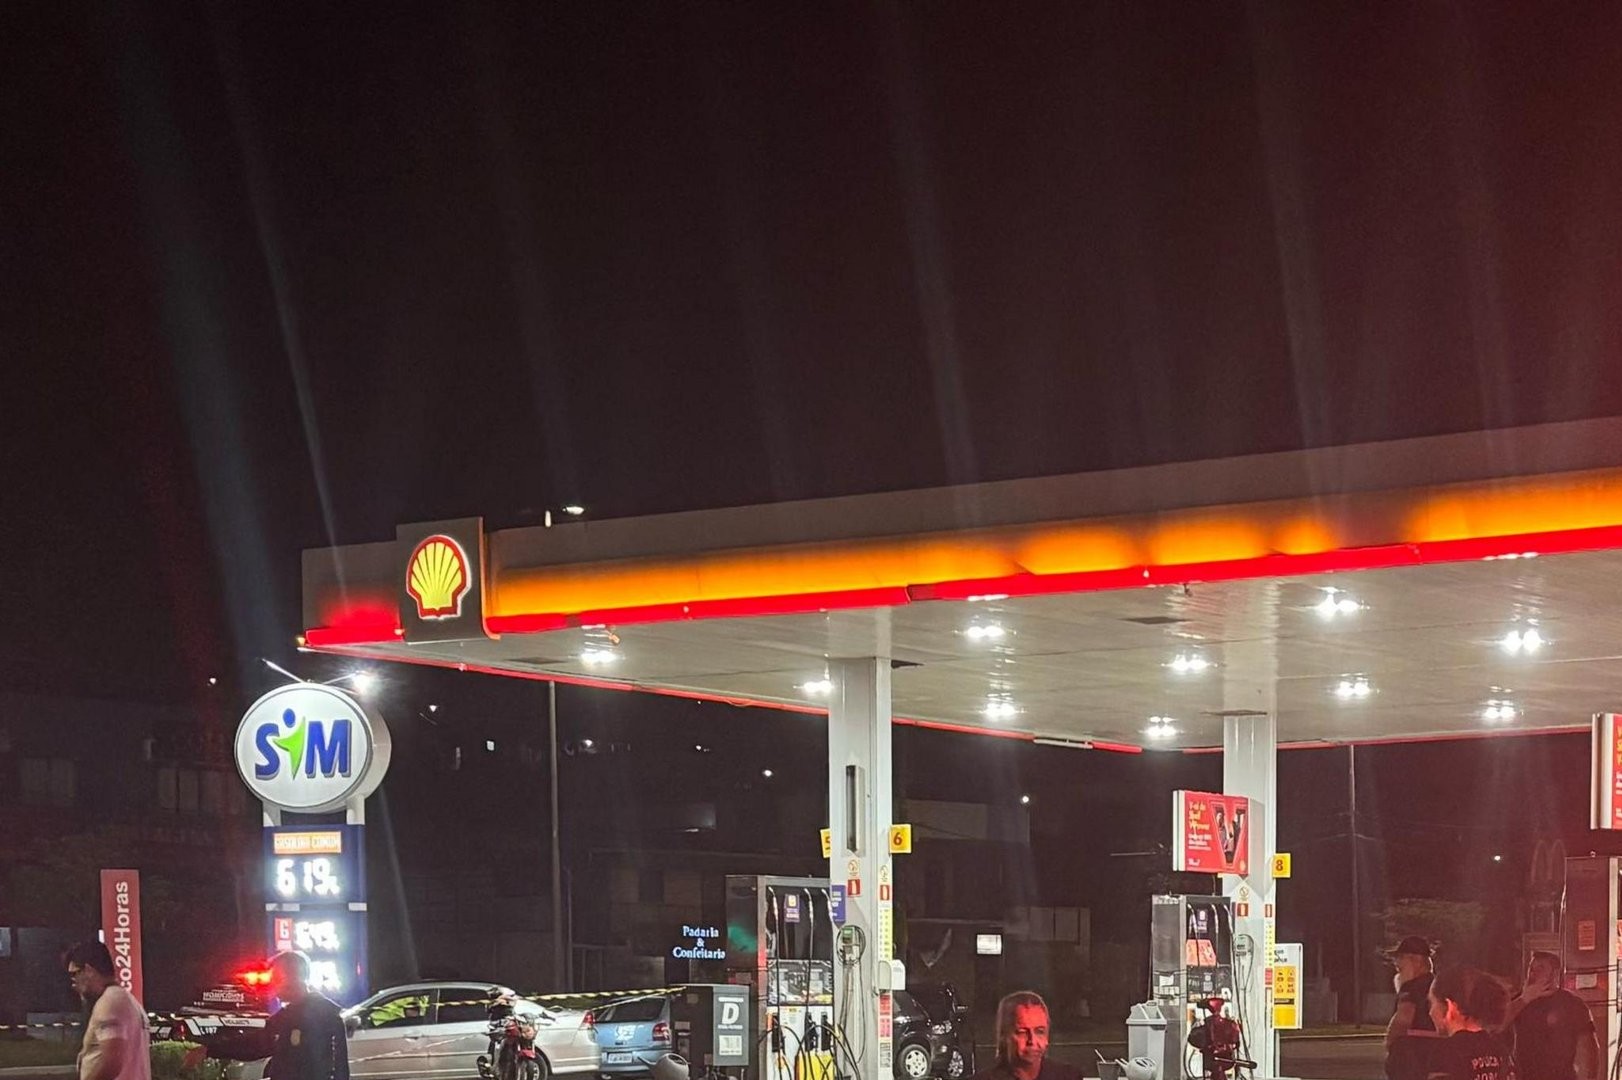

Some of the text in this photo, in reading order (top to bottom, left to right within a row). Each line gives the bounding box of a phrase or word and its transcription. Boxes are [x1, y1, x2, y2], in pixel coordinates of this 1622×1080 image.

[255, 708, 352, 781] SIM
[893, 832, 903, 846] 6
[1275, 859, 1284, 872] 8
[114, 881, 132, 992] co24Horas
[682, 925, 719, 938] Padaria
[696, 937, 705, 947] &
[672, 946, 726, 959] Confeitaria
